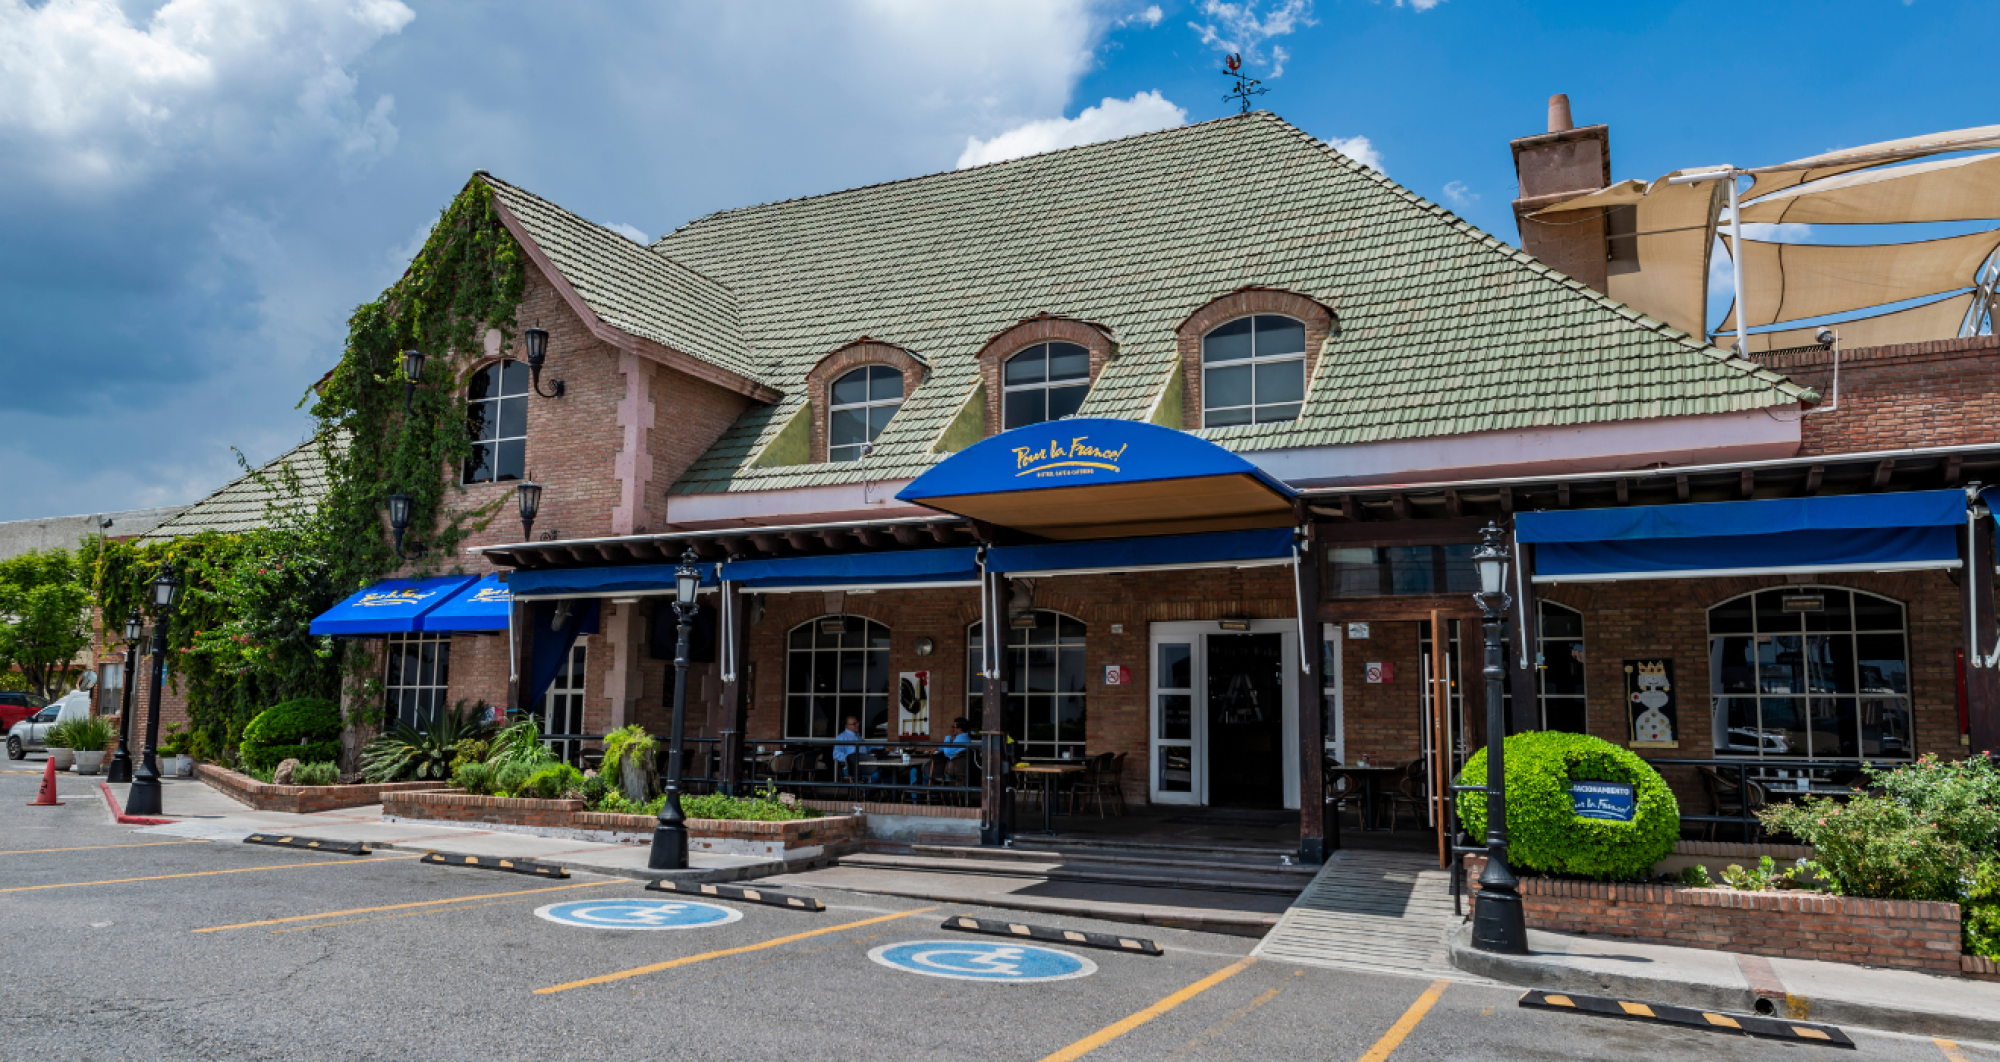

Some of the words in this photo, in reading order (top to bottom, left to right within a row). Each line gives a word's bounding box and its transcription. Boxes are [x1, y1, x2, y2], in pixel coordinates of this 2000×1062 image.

[1011, 446, 1047, 469] Pour
[1050, 440, 1067, 459] la
[1068, 436, 1128, 462] France!
[1568, 784, 1630, 795] TACIONAMIENTO
